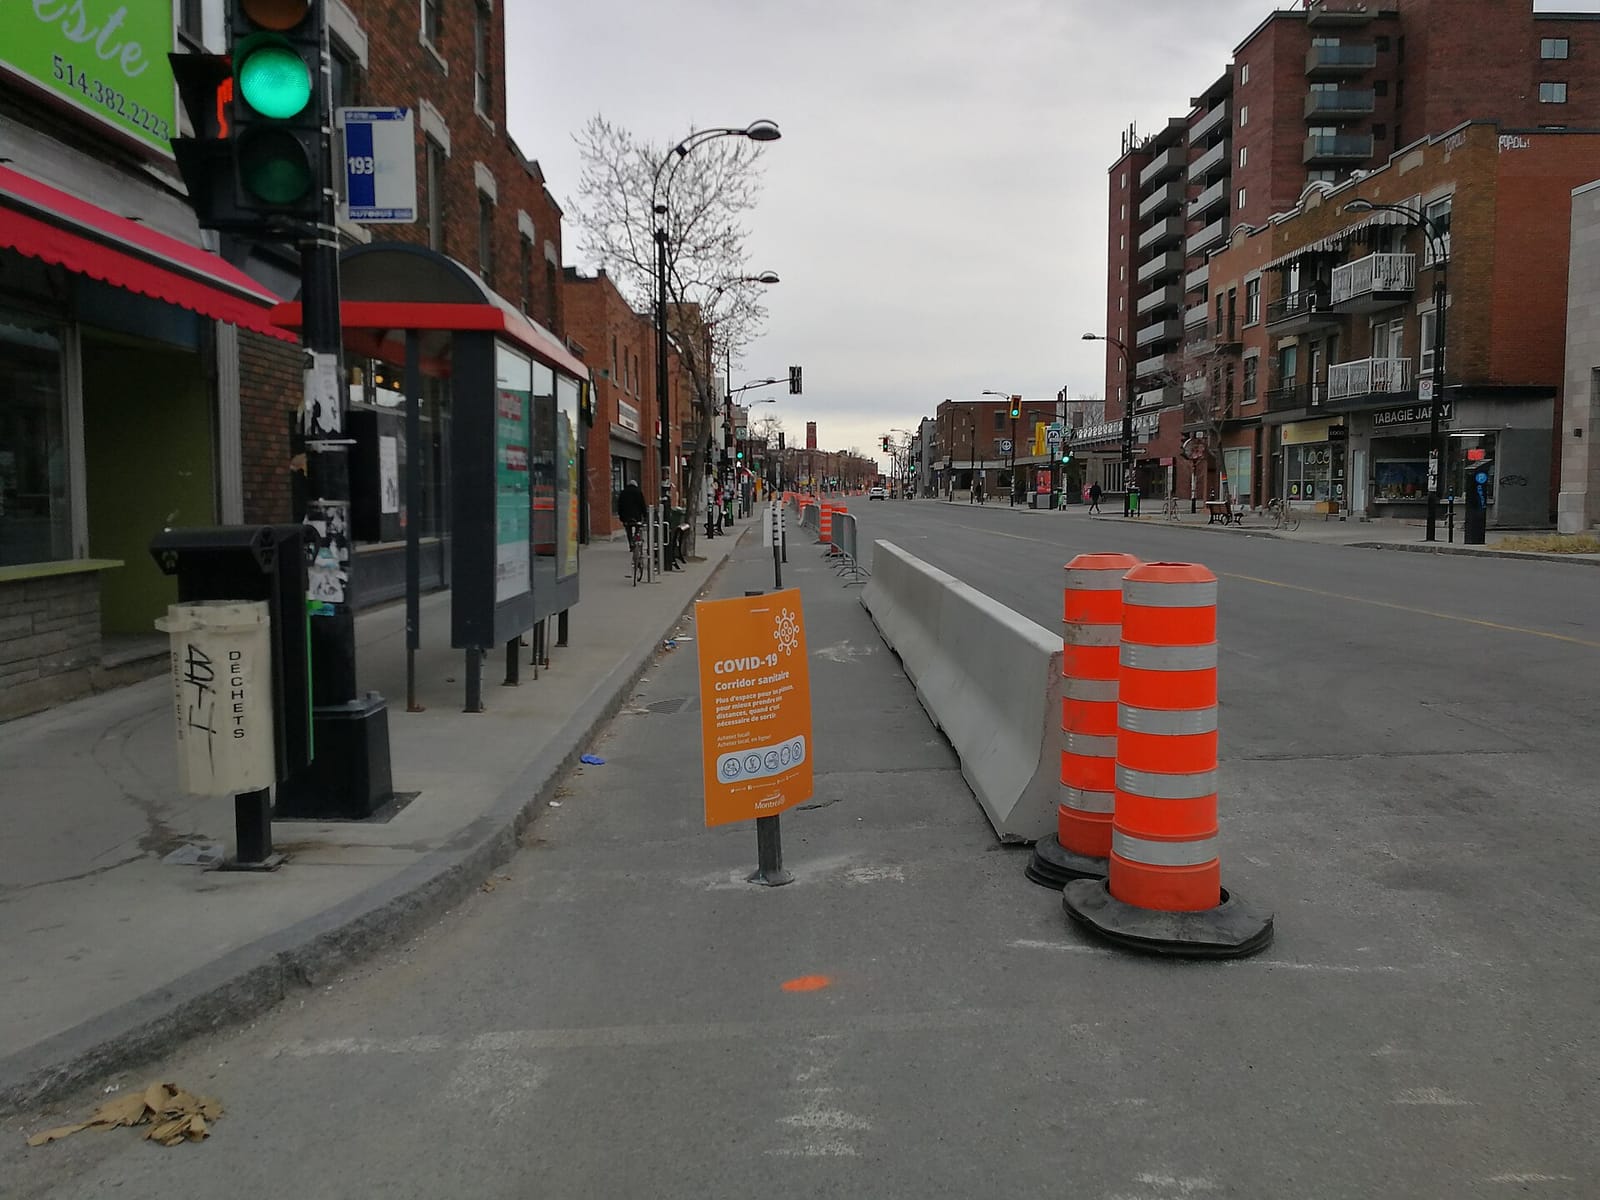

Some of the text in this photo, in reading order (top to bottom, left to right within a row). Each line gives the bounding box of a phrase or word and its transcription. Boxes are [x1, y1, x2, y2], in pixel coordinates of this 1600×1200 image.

[53, 54, 170, 142] 514.382.2223
[348, 156, 374, 175] 193
[1374, 409, 1414, 424] TABAGIE
[714, 653, 778, 674] COVID-19
[715, 671, 790, 691] Corridor sanitaire
[229, 650, 245, 739] DECHETS
